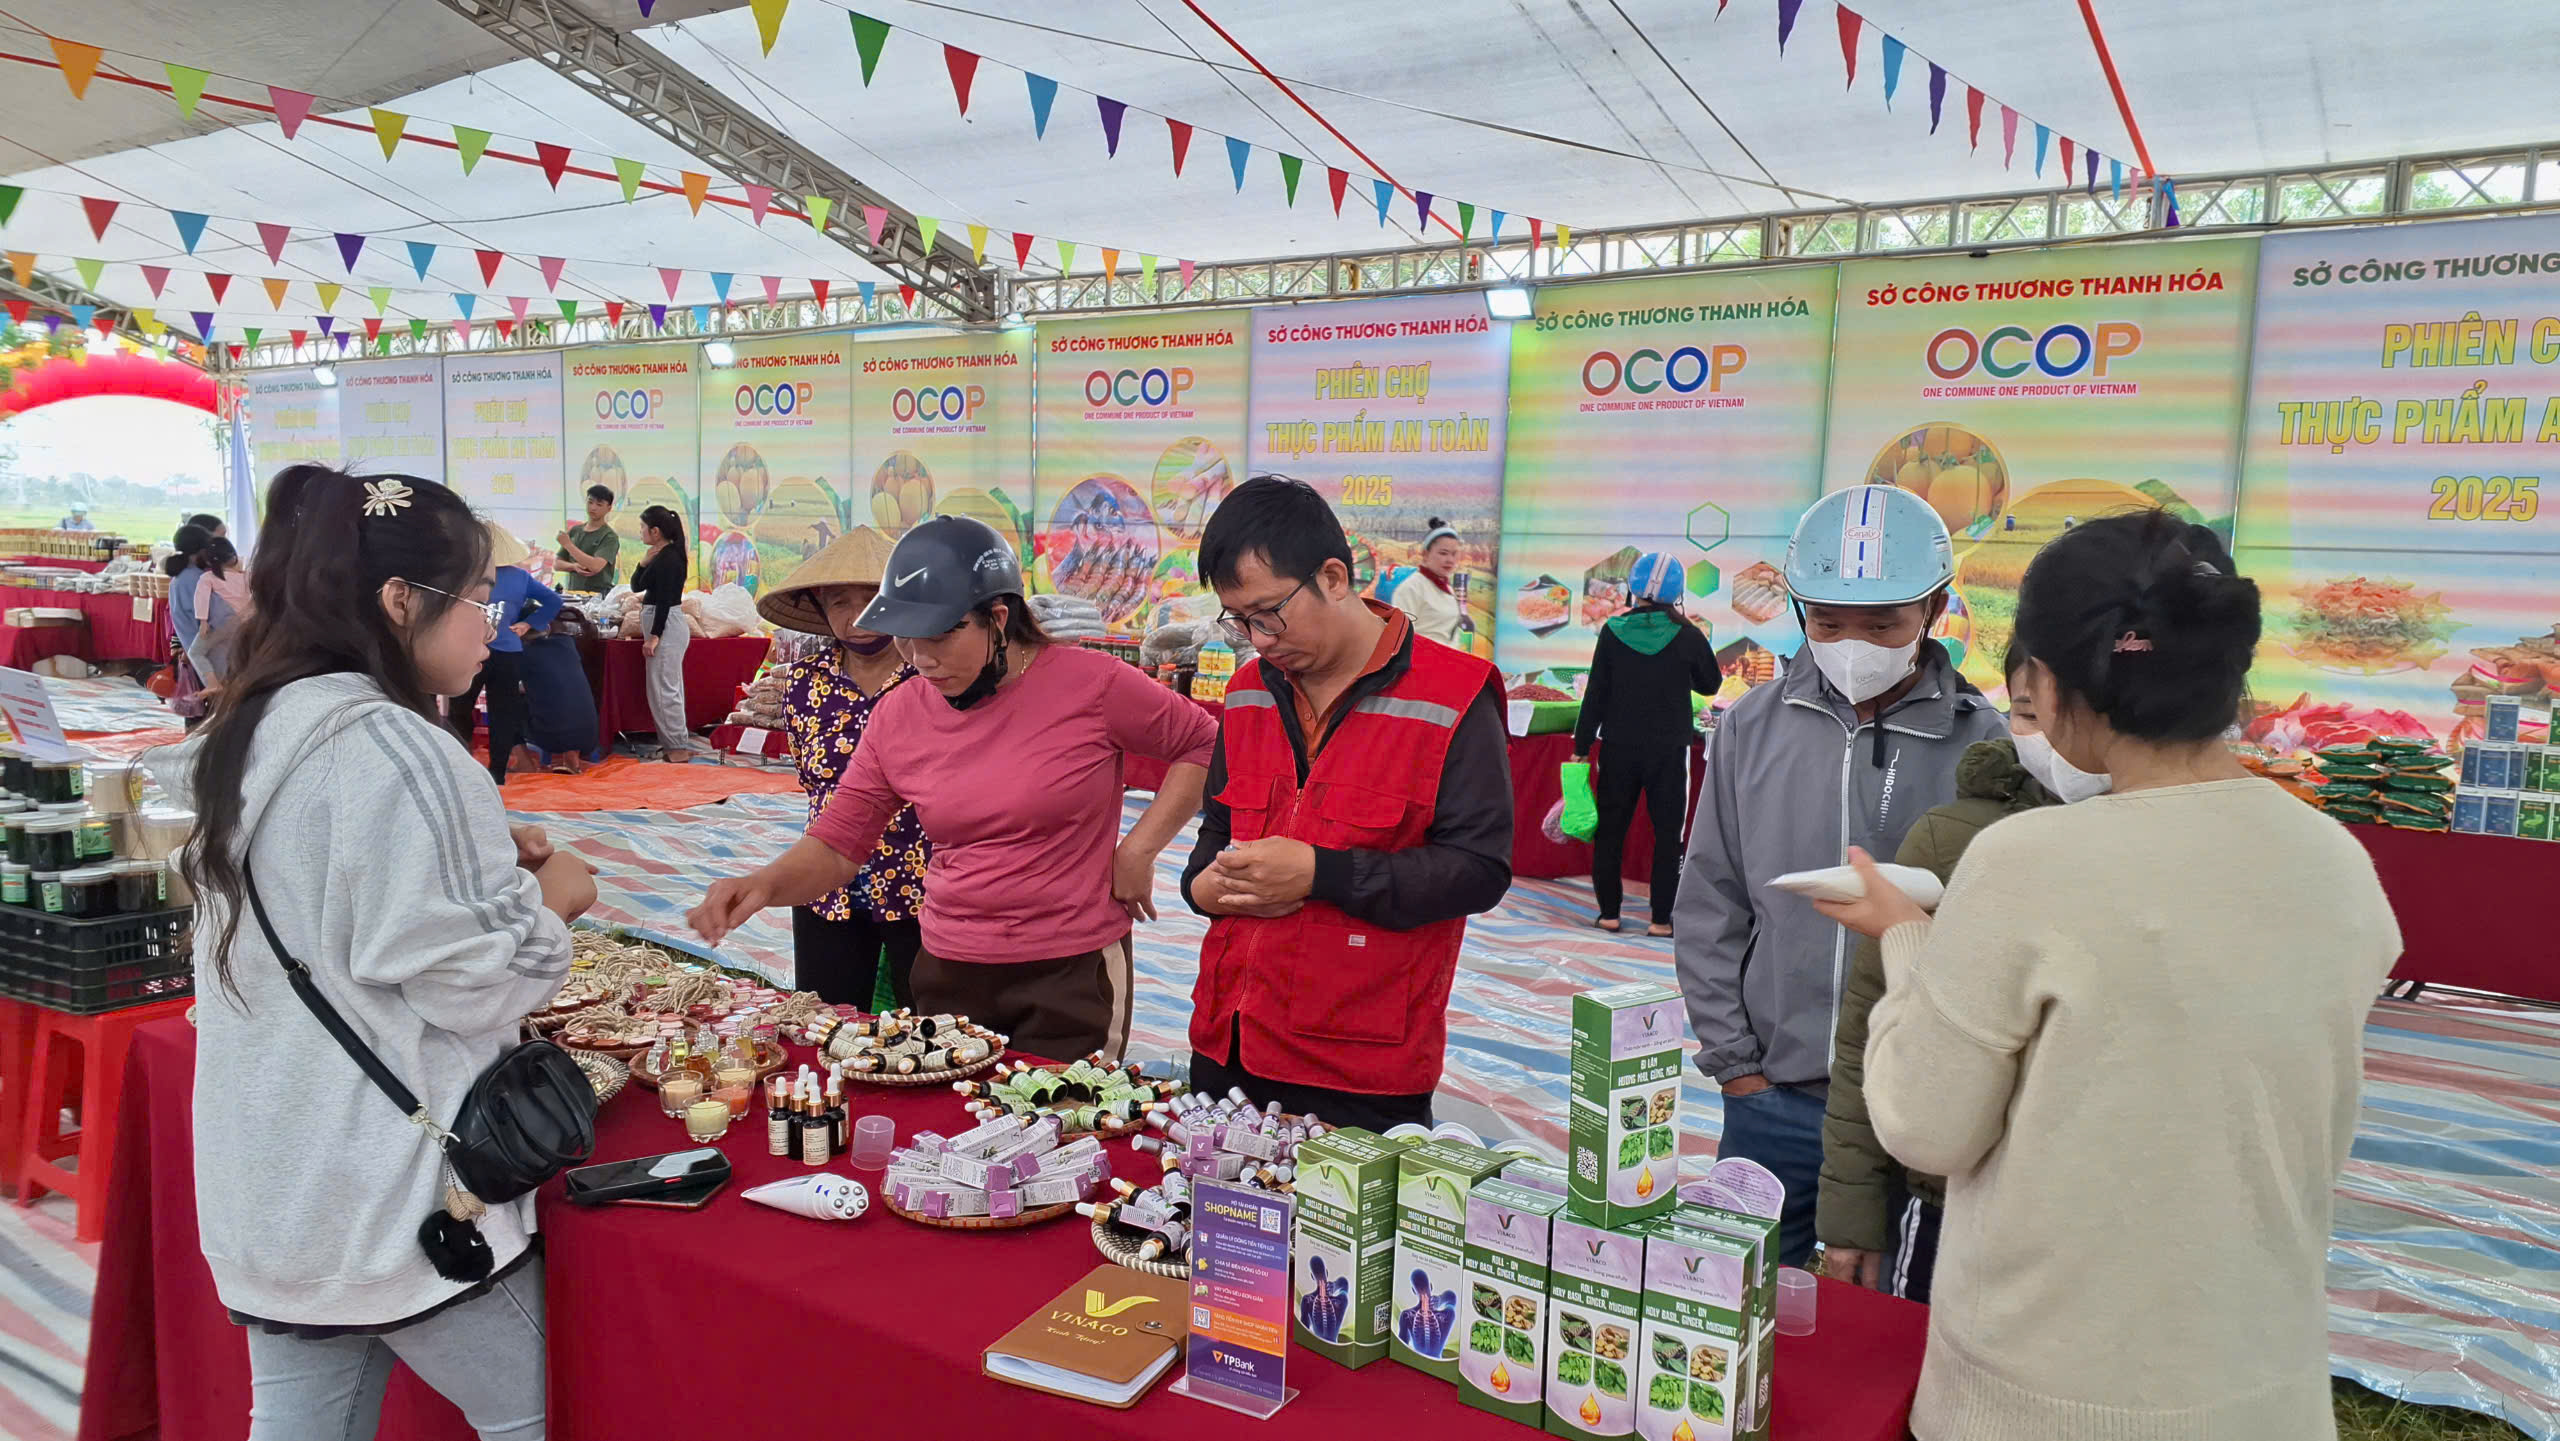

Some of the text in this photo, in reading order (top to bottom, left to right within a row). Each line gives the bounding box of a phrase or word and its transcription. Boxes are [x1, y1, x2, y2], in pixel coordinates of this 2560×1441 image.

[1867, 268, 2224, 306] SỞ CÔNG THƯƠNG THANH HÓA
[2292, 252, 2560, 287] SỞ CÔNG THƯƠNG
[1268, 315, 1489, 343] SỞ CÔNG THƯƠNG THANH HÓA
[1535, 296, 1810, 332] SỞ CÔNG THƯƠNG THANH HÓA
[1051, 329, 1234, 352] SỞ CÔNG THƯƠNG THANH HÓA
[1926, 322, 2142, 380] OCOP
[2381, 310, 2519, 369] PHIÊN
[789, 354, 818, 366] THANH
[863, 350, 1018, 373] SỞ CÔNG THƯƠNG THANH HÓA
[1582, 344, 1747, 397] OCOP
[735, 382, 813, 417] OCOP
[1085, 367, 1194, 407] OCOP
[1315, 360, 1432, 404] PHIÊN CHỢ
[1923, 383, 2137, 398] ONE COMMUNE ONE PRODUCT OF VIETNAM
[596, 389, 663, 419] OCOP
[892, 385, 986, 422] OCOP
[1580, 398, 1745, 412] ONE COMMUNE ONE PRODUCT OF VIETNAM
[2278, 396, 2383, 454] THỰC
[2393, 379, 2528, 444] PHẨM
[1266, 408, 1490, 460] THỰC PHẨM AN TOÀN
[1341, 474, 1393, 507] 2025
[2427, 475, 2540, 522] 2025
[1204, 1201, 1258, 1222] SHOPNAME
[1049, 1309, 1129, 1337] VINACO
[1223, 1354, 1255, 1372] TPBank
